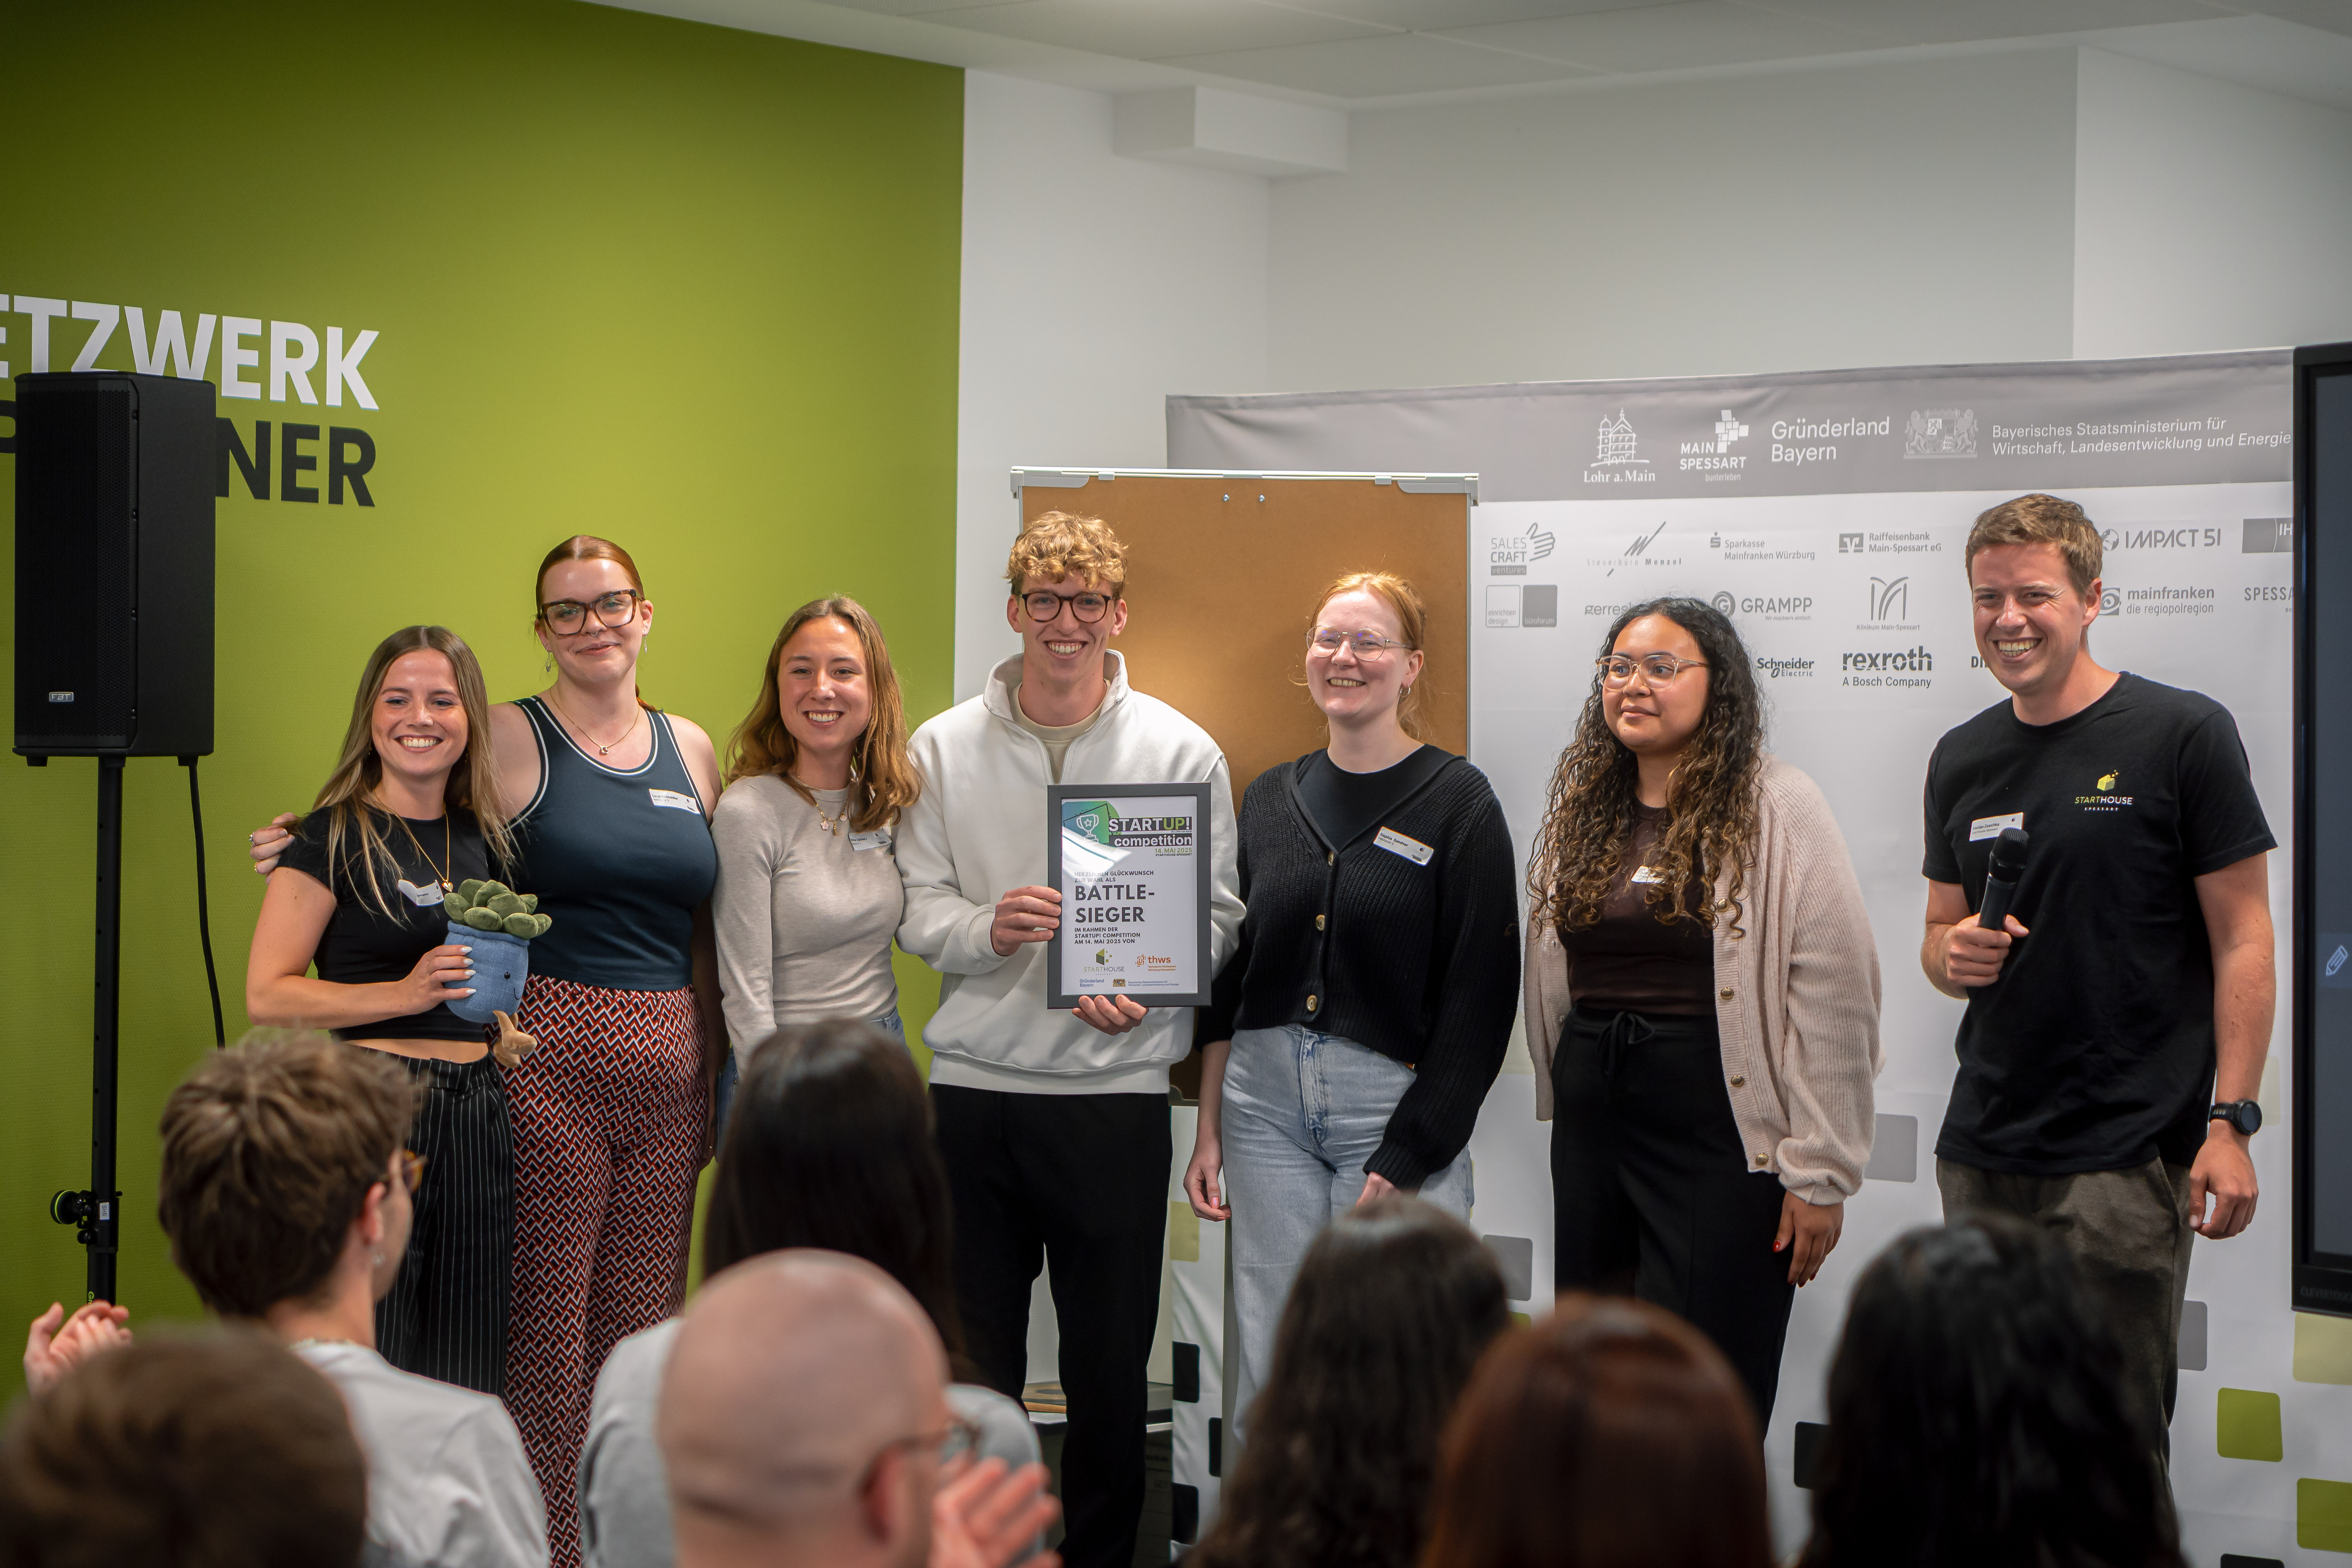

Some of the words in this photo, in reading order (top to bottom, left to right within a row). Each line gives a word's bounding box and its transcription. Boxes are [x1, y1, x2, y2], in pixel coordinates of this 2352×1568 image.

[0, 294, 379, 410] TZWERK
[1771, 416, 1890, 441] Gründerland
[1992, 424, 2073, 440] Bayerisches
[2076, 419, 2202, 436] Staatsministerium
[2207, 417, 2226, 430] für
[1680, 442, 1714, 454] MAIN
[1992, 440, 2066, 456] Wirtschaft,
[2071, 436, 2202, 453] Landesentwicklung
[2207, 434, 2234, 447] und
[2238, 431, 2292, 450] Energie
[1771, 443, 1837, 466] Bayern
[1679, 456, 1747, 470] SPESSART
[1584, 471, 1610, 483] Lohr
[1625, 470, 1656, 482] Main
[1705, 473, 1741, 482] bunterleben
[1869, 532, 1930, 541] Raiffeisenbank
[2125, 528, 2199, 548] IMPACT
[1491, 537, 1527, 550] SALES
[1724, 539, 1765, 550] Sparkasse
[1869, 543, 1928, 554] Main-Spessart
[1930, 543, 1942, 552] eG
[1491, 551, 1527, 563] CRAFT
[1724, 551, 1774, 560] Mainfranken
[1775, 550, 1815, 561] Würzburg
[2127, 586, 2214, 601] mainfranken
[1741, 597, 1813, 613] GRAMPP
[2127, 603, 2141, 614] die
[2143, 602, 2214, 617] regiopolregion
[1488, 617, 1508, 626] design
[1524, 617, 1555, 625] büroforum
[1757, 657, 1815, 670] Schneider
[1842, 645, 1933, 671] rexroth
[1781, 669, 1813, 677] Electric
[1842, 677, 1849, 686] A
[1853, 676, 1882, 687] Bosch
[1886, 676, 1932, 689] Company
[2074, 796, 2134, 805] STARTHOUSE
[1109, 817, 1190, 832] STARTUP!
[1114, 834, 1192, 847] competition
[1075, 884, 1155, 901] BATTLE-
[1075, 906, 1145, 923] SIEGER
[1147, 955, 1171, 964] thws
